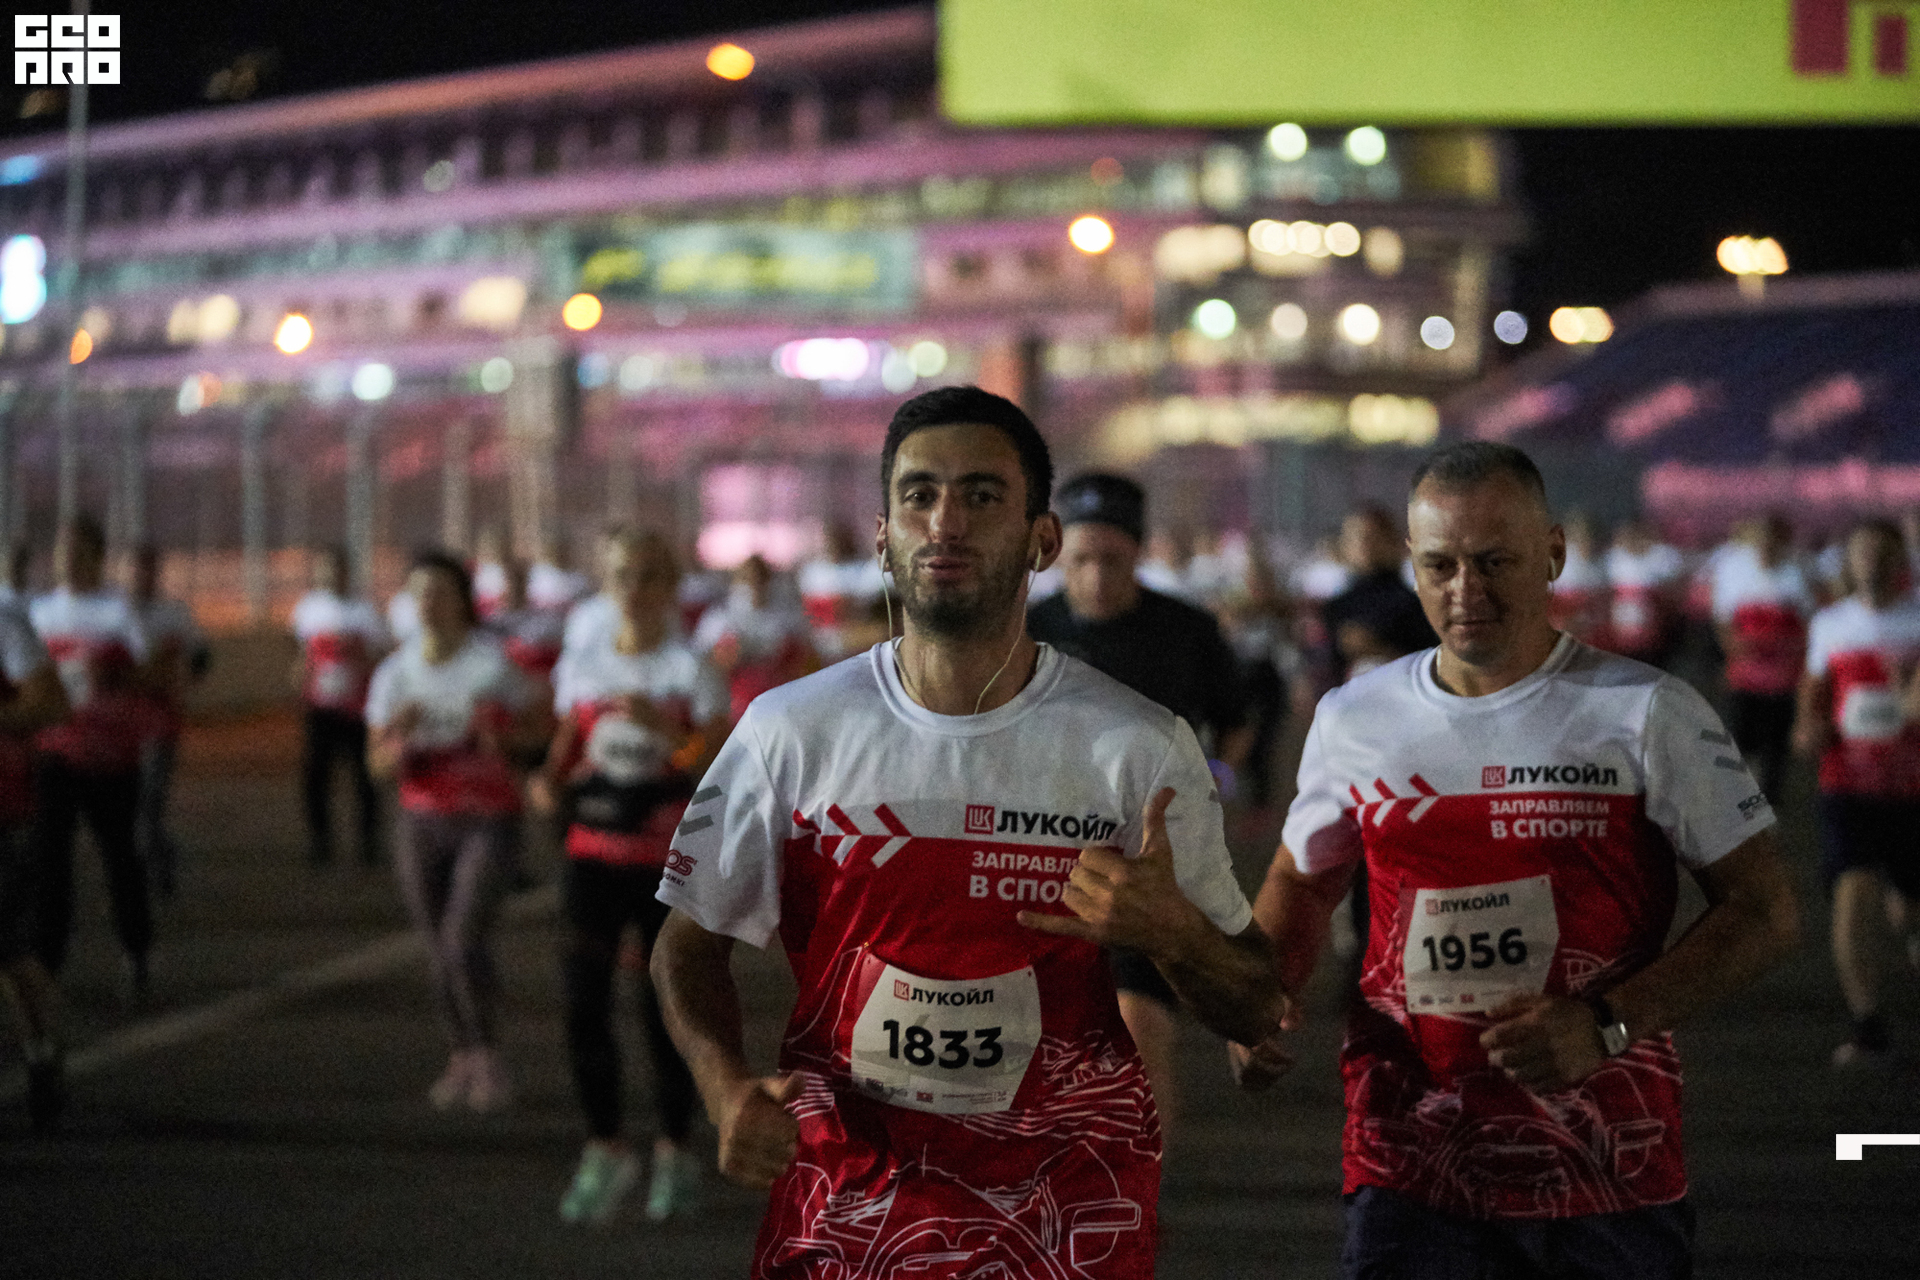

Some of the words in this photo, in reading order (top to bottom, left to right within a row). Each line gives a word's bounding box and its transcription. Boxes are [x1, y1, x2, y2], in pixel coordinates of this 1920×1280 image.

[1507, 763, 1618, 786] ЛУКОЙЛ
[1489, 800, 1609, 815] ЗАПРАВЛЯЕМ
[997, 810, 1117, 841] ЛУКОЙЛ
[1491, 820, 1508, 839] В
[1513, 818, 1608, 838] СПОРТЕ
[972, 851, 1079, 873] ЗАПРАВЛ
[969, 875, 989, 898] В
[997, 877, 1070, 903] СПО
[1439, 893, 1510, 912] ЛУКОЙЛ
[1423, 928, 1527, 971] 1956
[911, 988, 994, 1006] ЛУКОЙЛ
[883, 1019, 1003, 1069] 1833
